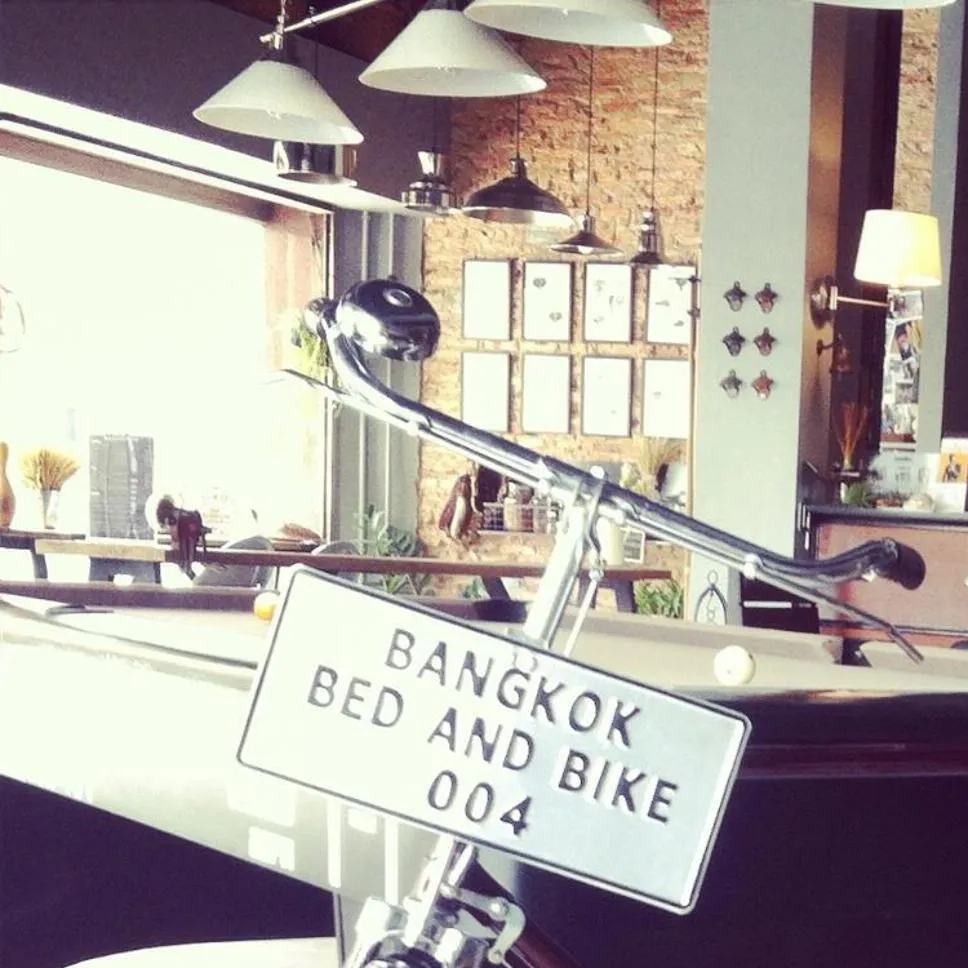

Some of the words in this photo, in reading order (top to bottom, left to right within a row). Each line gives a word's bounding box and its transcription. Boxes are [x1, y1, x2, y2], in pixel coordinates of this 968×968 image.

[307, 664, 404, 729] BED
[427, 706, 536, 771] AND
[558, 748, 679, 824] BIKE
[385, 628, 641, 748] BANGKOK
[427, 769, 533, 837] 004
